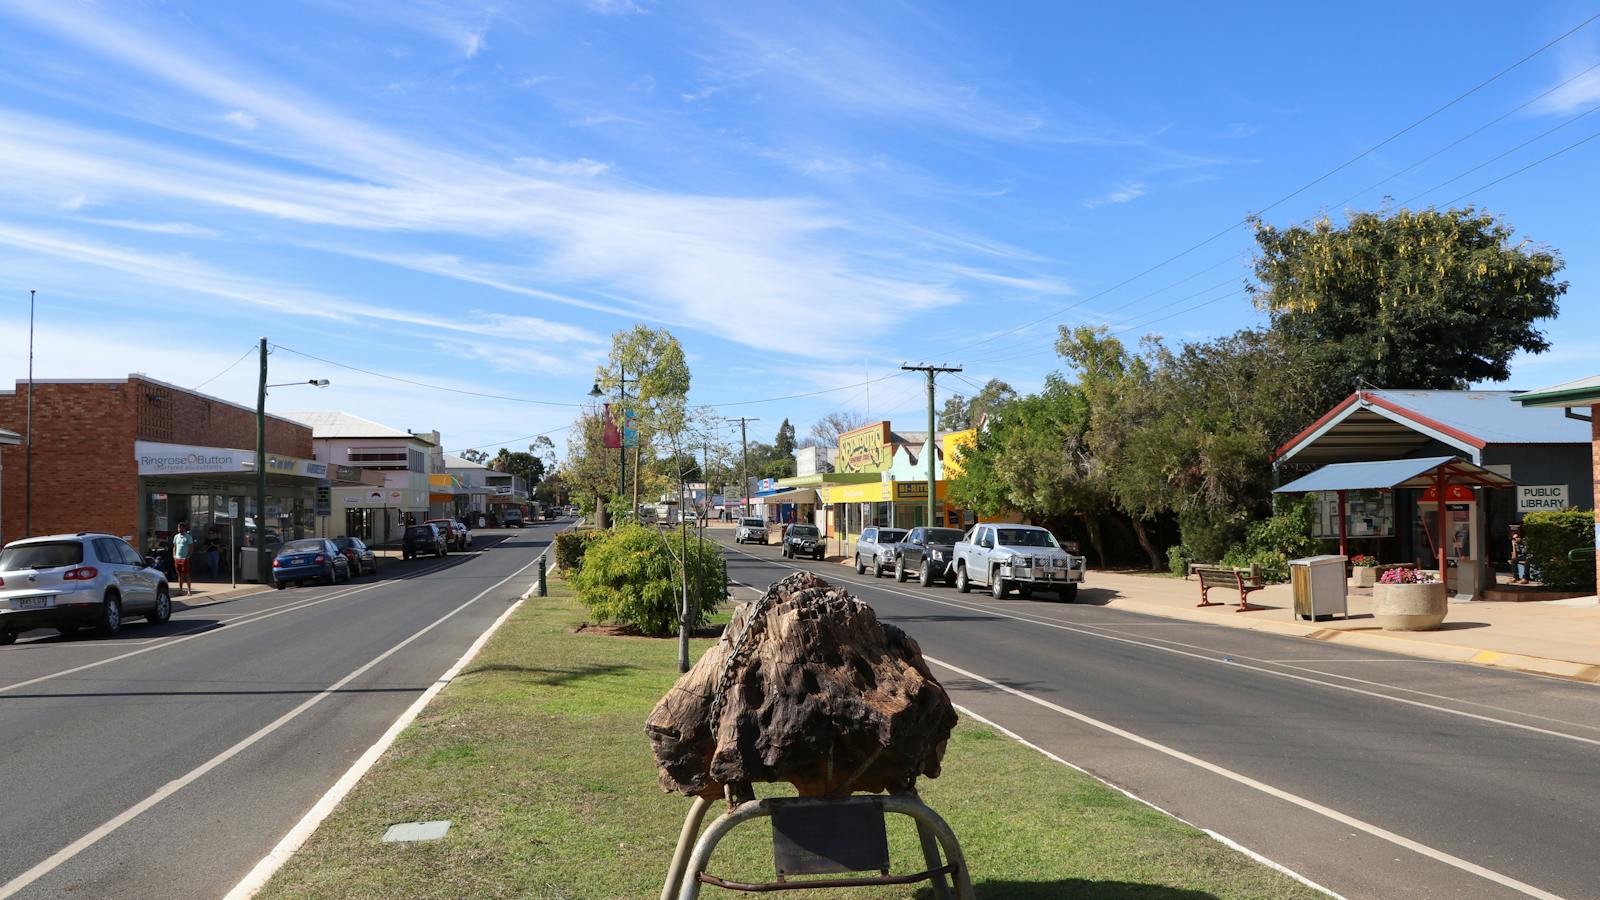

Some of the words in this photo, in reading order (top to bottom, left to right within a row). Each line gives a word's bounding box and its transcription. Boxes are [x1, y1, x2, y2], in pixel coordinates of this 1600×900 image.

[141, 455, 185, 467] Ringrose
[197, 455, 233, 464] Button
[1524, 488, 1561, 497] PUBLIC
[1521, 499, 1564, 508] LIBRARY
